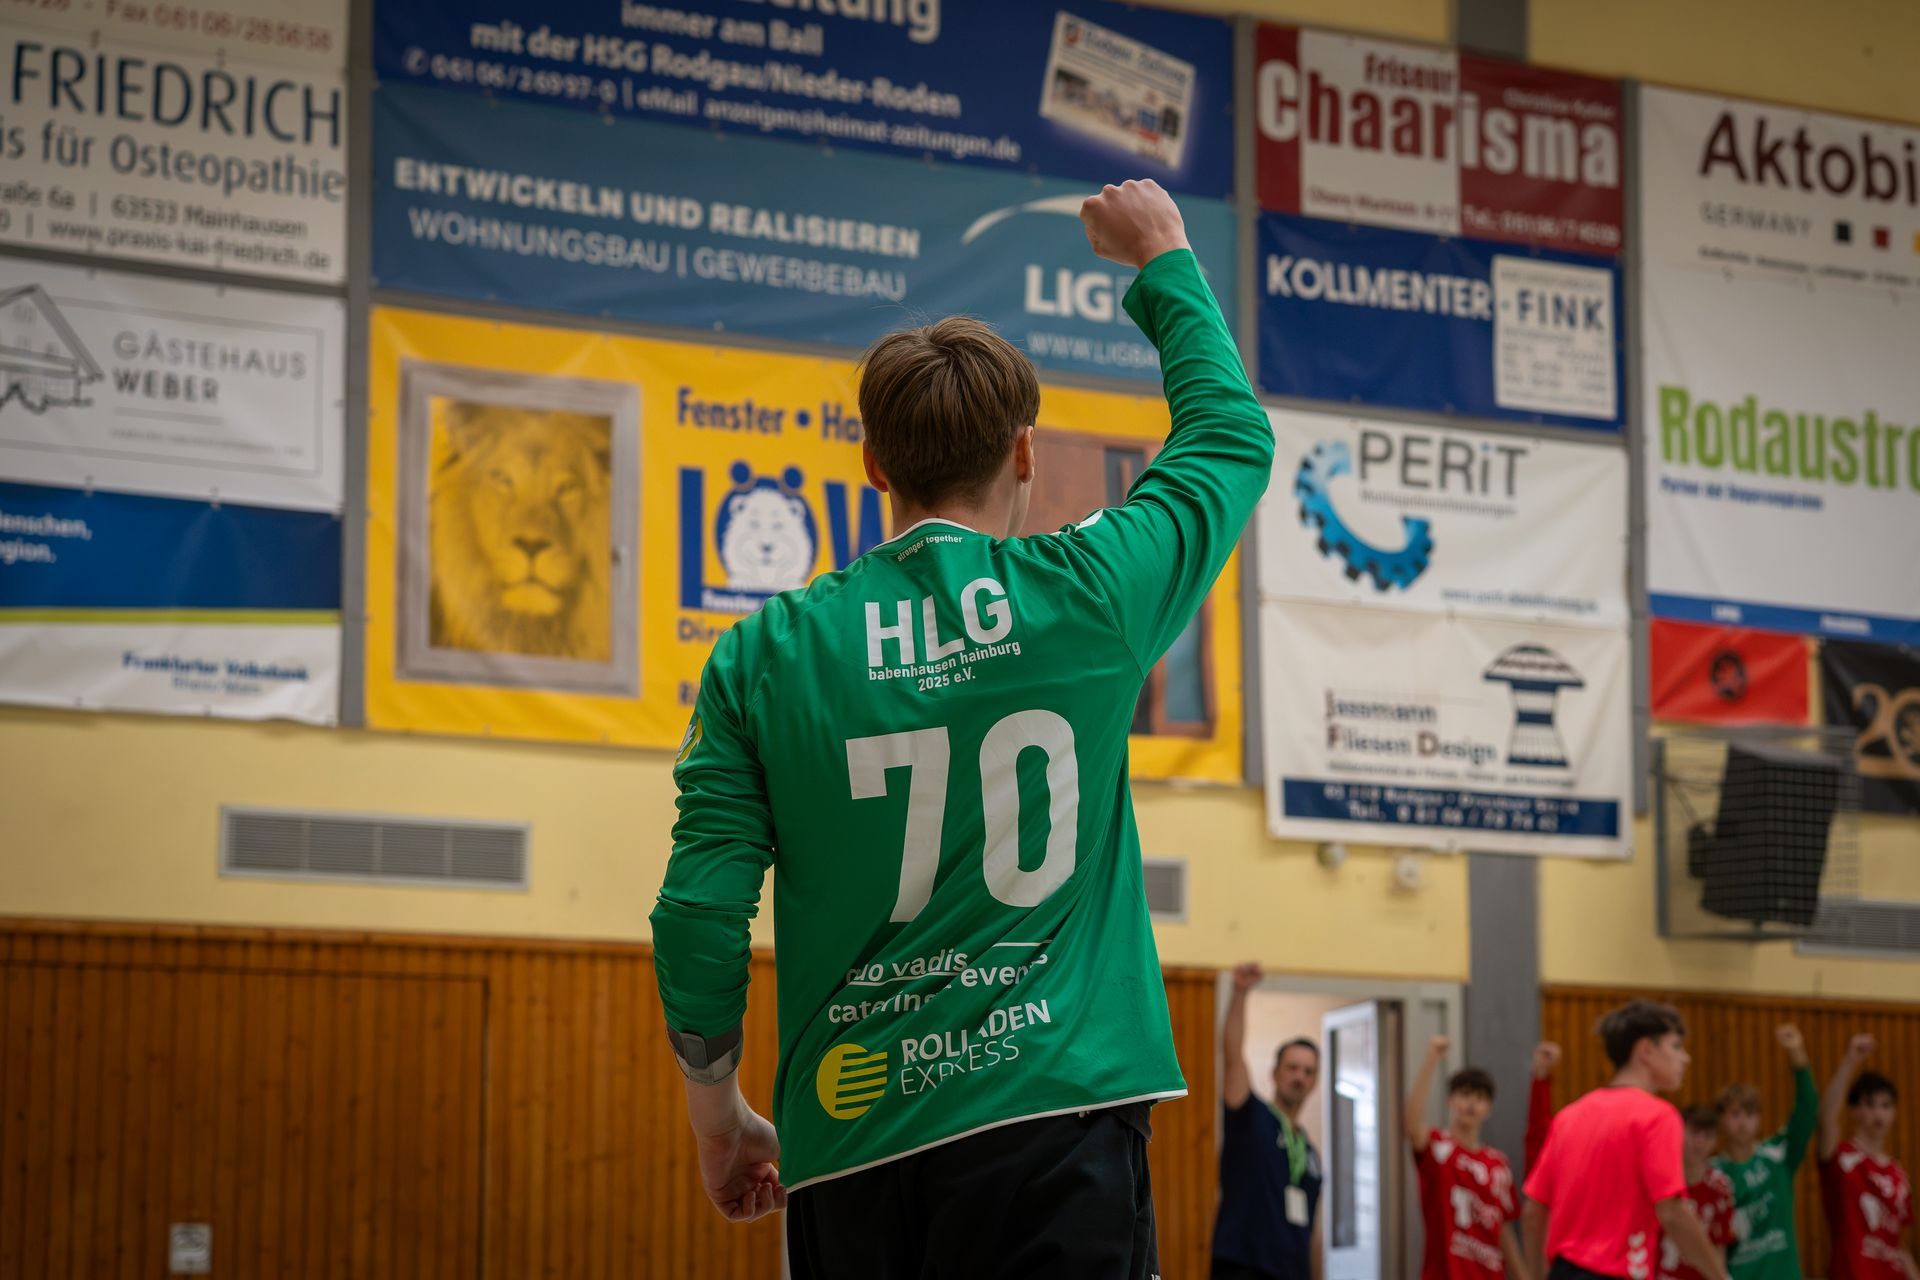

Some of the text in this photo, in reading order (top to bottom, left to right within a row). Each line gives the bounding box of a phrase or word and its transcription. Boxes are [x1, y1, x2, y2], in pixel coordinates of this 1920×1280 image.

[719, 18, 766, 46] am
[769, 19, 824, 56] Ball
[471, 19, 962, 118] mit der HSG Rodgau/Nieder-Roden
[1364, 51, 1458, 93] Friseur
[12, 41, 342, 148] FRIEDRICH
[1257, 58, 1619, 189] Chaarisma
[42, 118, 96, 169] für
[109, 133, 346, 202] Osteopathie
[394, 156, 920, 259] ENTWICKELN UND REALISIEREN
[407, 206, 671, 273] WOHNUNGSBAU
[693, 245, 907, 301] GEWERBEBAU
[1267, 254, 1494, 321] KOLLMENTER
[1517, 287, 1604, 331] FINK
[112, 367, 220, 405] WEBER
[677, 385, 786, 436] Fenster
[897, 533, 964, 562] stronger together
[864, 577, 1013, 667] HLG
[868, 641, 1022, 682] babenhausen hainburg
[918, 666, 977, 692] 2025 e.V.
[845, 709, 1080, 923] 70
[891, 948, 969, 977] vadis
[960, 953, 1049, 988] evens
